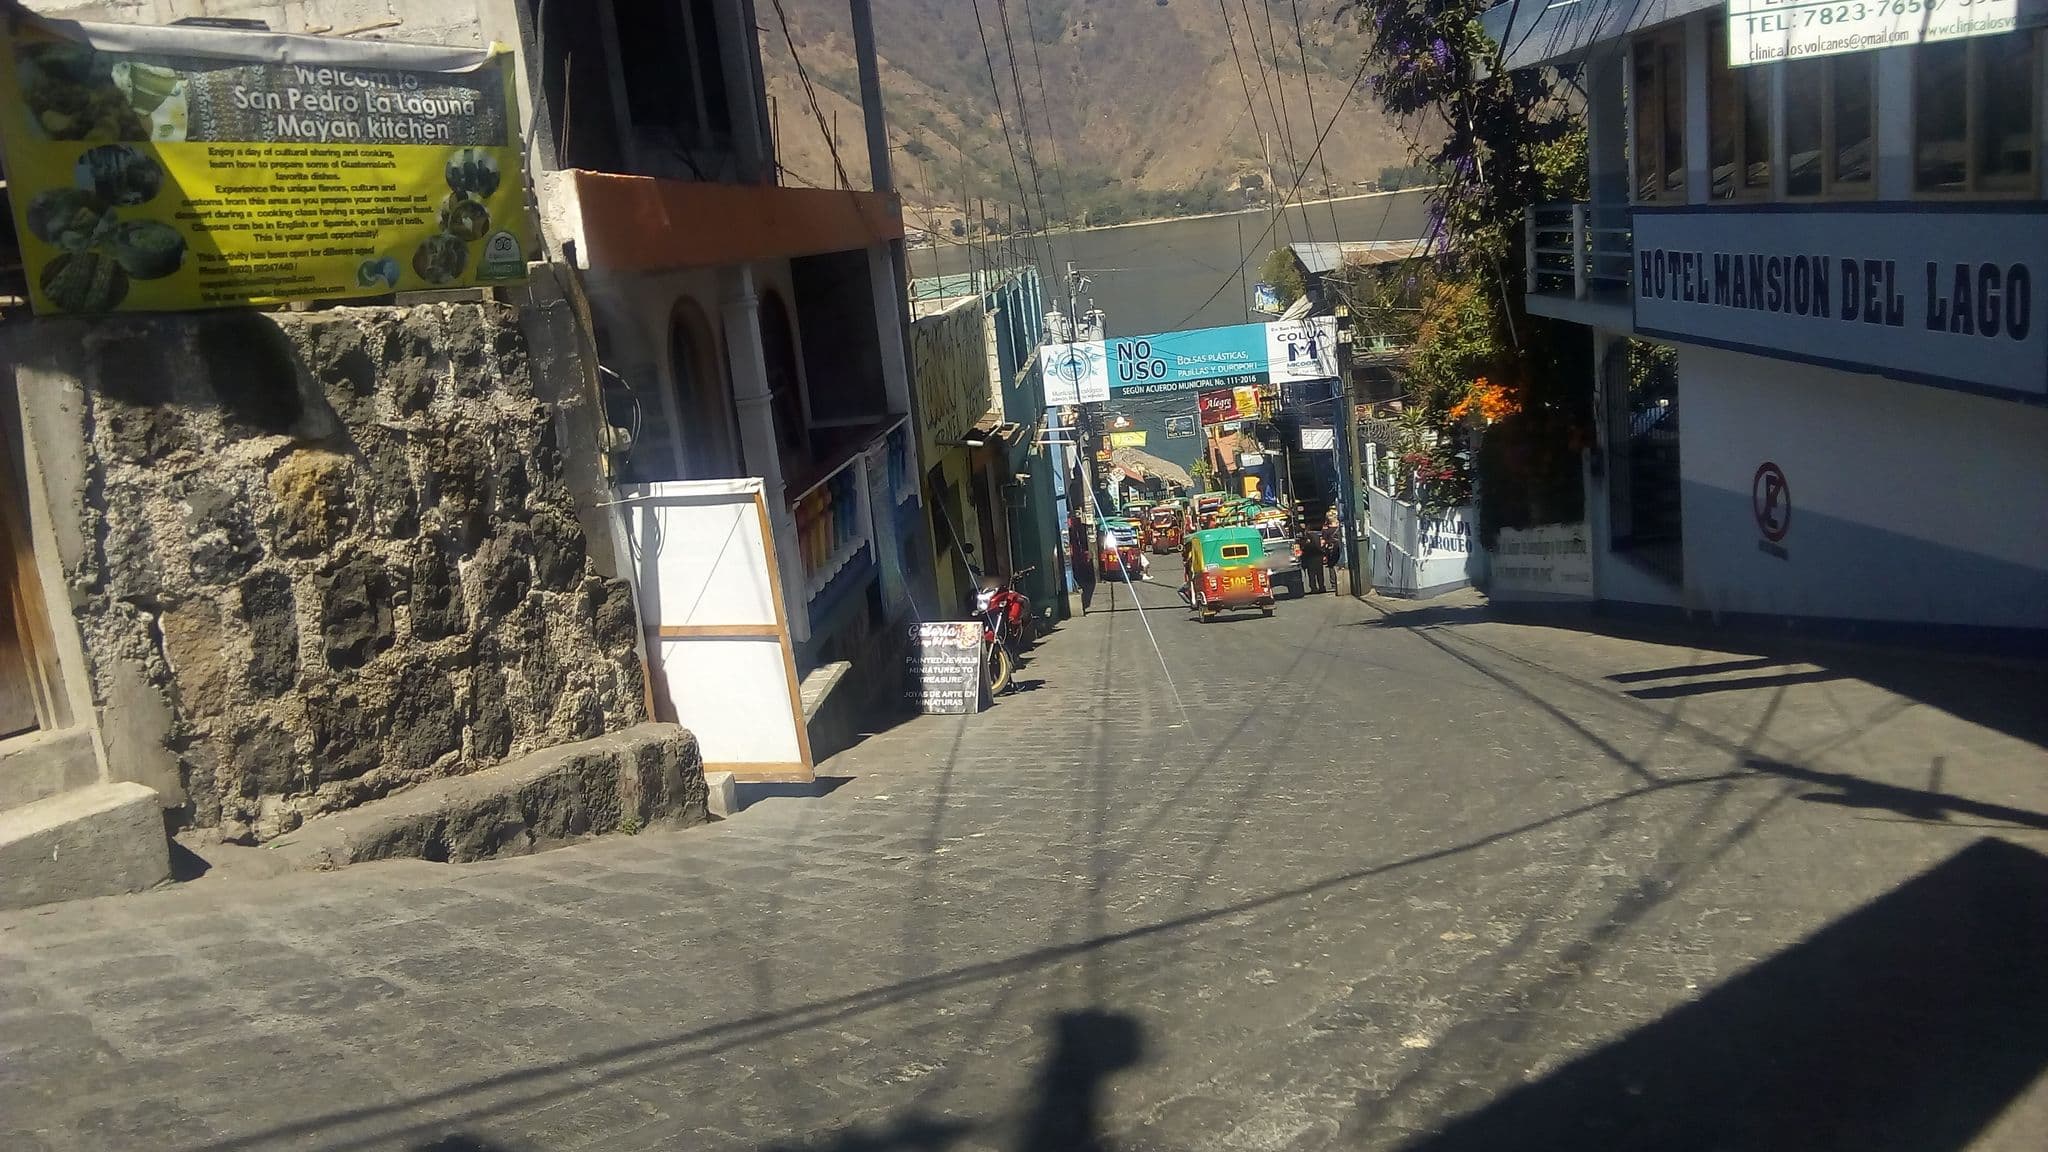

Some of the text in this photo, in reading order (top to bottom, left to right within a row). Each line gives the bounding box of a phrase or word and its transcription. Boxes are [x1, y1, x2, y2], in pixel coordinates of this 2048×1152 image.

[1746, 14, 1797, 35] TEL:
[234, 85, 475, 120] San Pedro La Laguna
[277, 115, 450, 142] Mayan kitchen
[1641, 248, 2032, 342] HOTEL MANSION DEL LAGO
[1117, 341, 1151, 362] NO
[1119, 359, 1167, 381] USO
[1122, 375, 1257, 395] SEGÚN ACUERDO MUNICIPAL No. 111-2016
[1420, 517, 1472, 536] ENTRADA
[1420, 533, 1473, 553] PARQUEO
[906, 656, 941, 664] PAINTED
[909, 666, 960, 674] MINIATURES
[904, 690, 929, 698] JOYAS
[930, 690, 941, 698] DE
